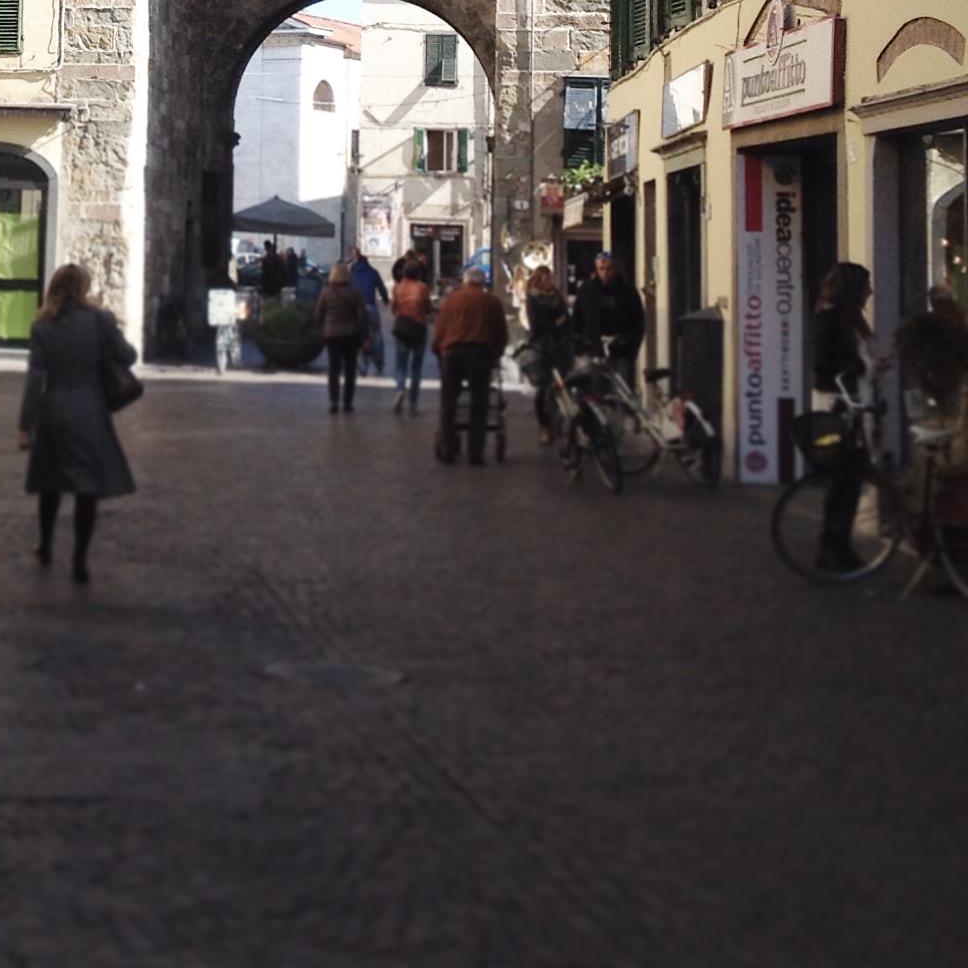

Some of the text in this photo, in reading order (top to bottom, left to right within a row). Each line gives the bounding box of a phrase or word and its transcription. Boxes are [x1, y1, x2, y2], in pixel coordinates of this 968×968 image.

[741, 52, 806, 107] puntoaffitto
[776, 191, 796, 315] ideacentro
[744, 294, 765, 447] puntoaffitto
